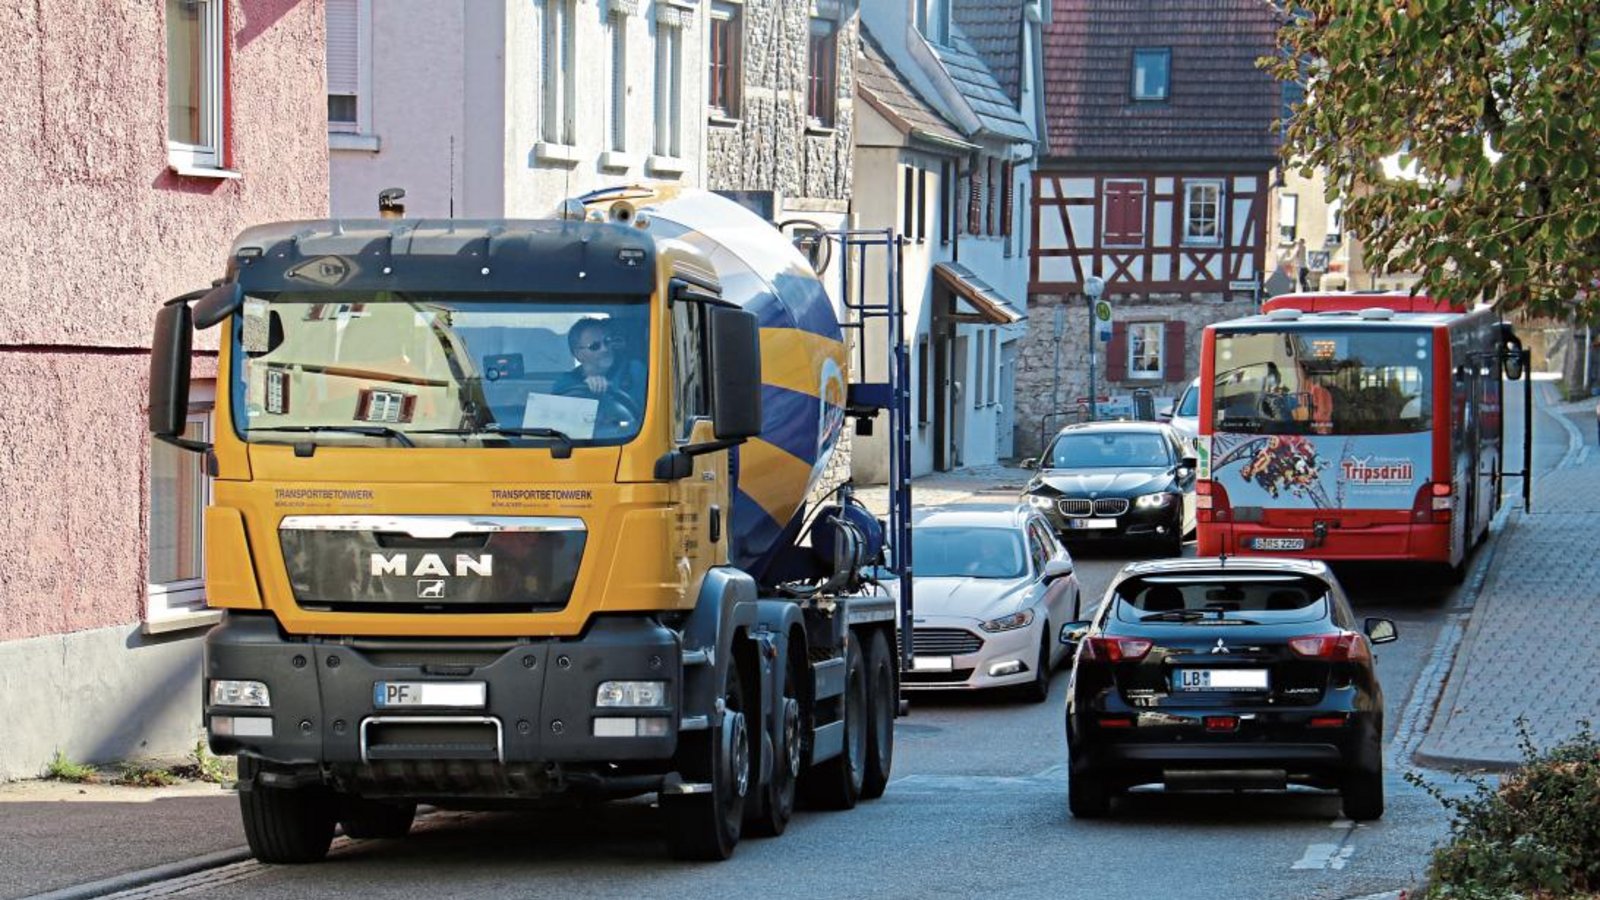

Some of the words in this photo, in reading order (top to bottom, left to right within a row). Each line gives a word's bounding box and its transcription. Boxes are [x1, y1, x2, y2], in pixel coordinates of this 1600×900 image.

[1342, 462, 1412, 484] Tripsdrill
[274, 489, 374, 500] TRANSPORTBETONWERK
[491, 489, 592, 501] TRANSPORTBETONWERK
[371, 553, 493, 576] MAN
[1183, 671, 1200, 686] LB
[387, 685, 409, 703] PF
